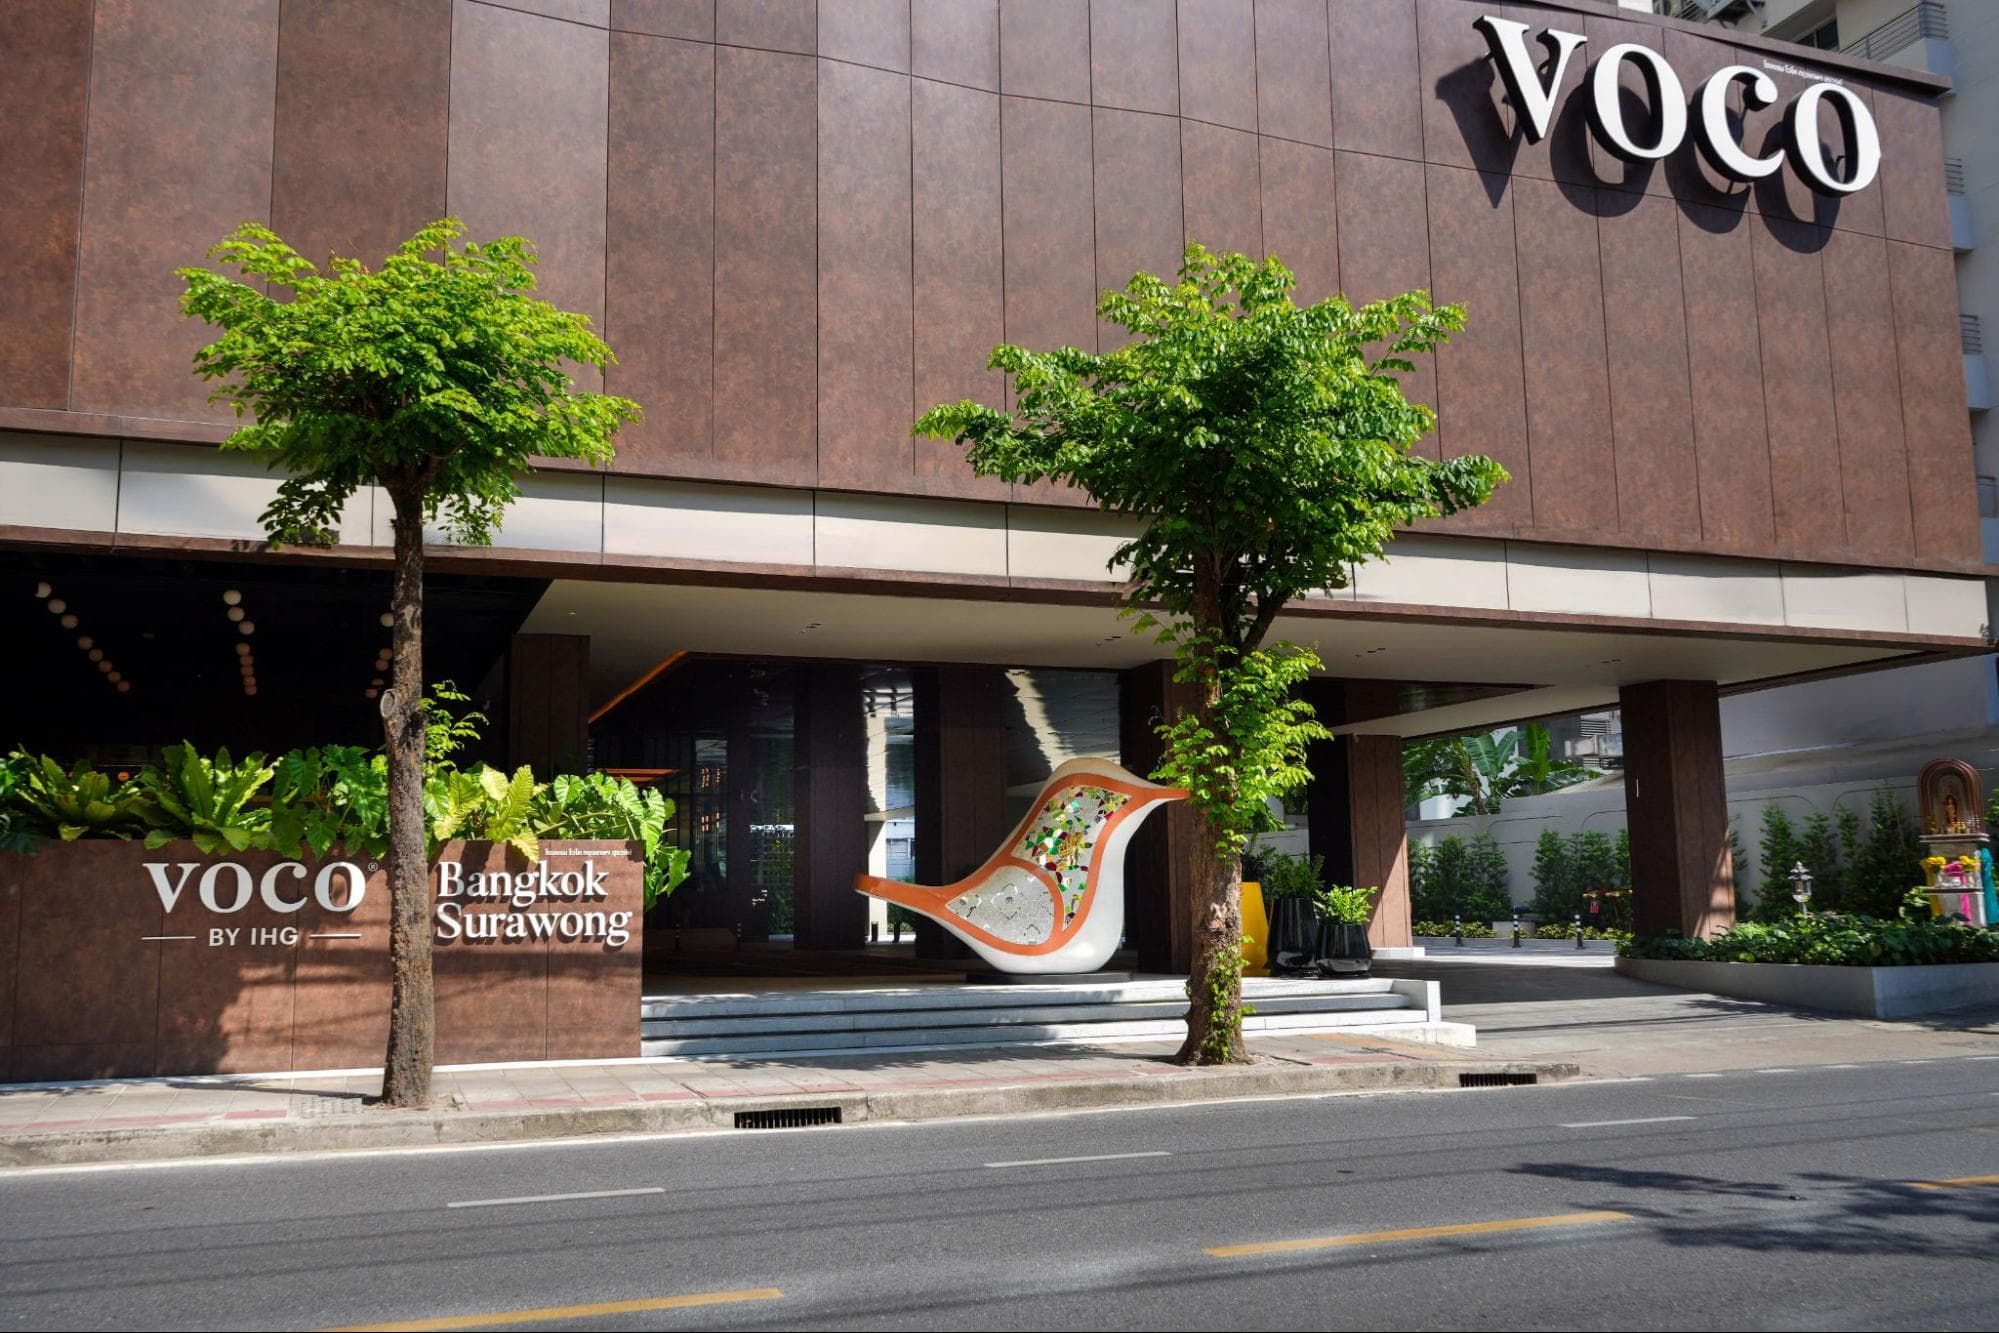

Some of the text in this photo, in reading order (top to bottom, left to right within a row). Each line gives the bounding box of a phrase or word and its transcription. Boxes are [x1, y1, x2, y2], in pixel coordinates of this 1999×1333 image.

[437, 859, 609, 908] Bangkok
[208, 927, 299, 947] BY IHG
[437, 902, 633, 947] Surawong
